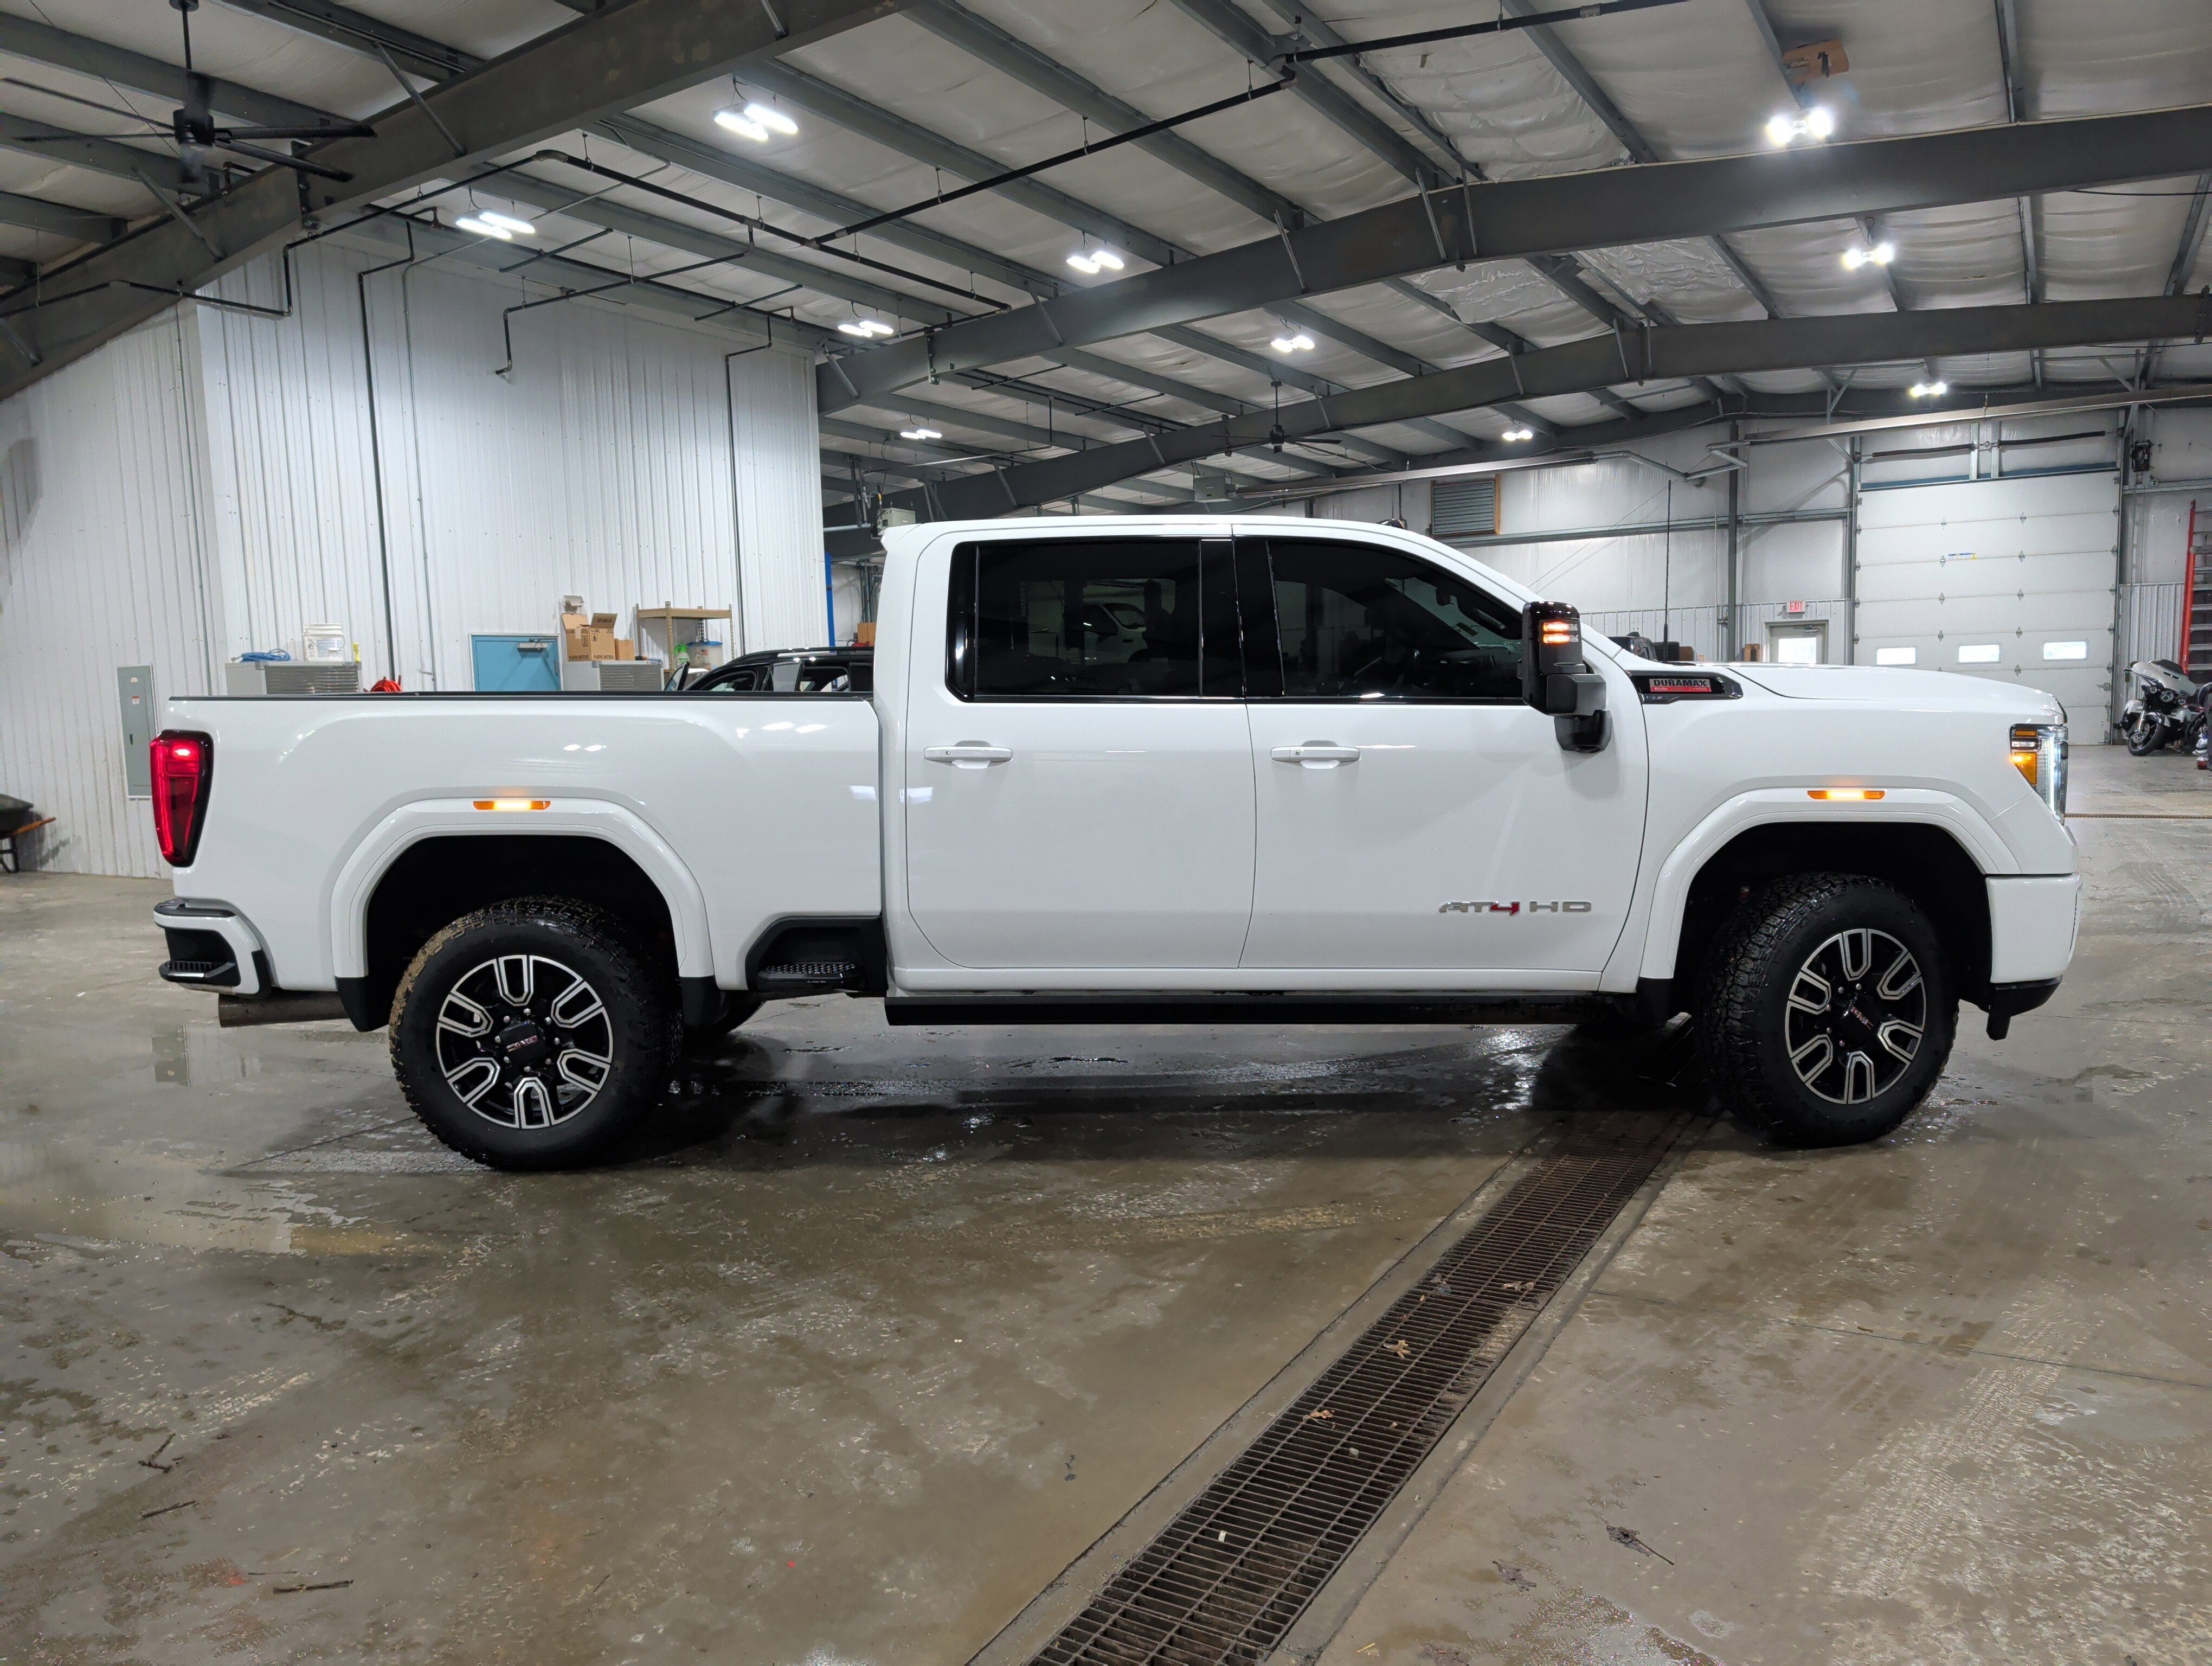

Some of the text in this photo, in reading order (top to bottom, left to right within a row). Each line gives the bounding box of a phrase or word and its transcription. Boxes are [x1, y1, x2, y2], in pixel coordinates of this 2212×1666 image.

[1790, 601, 1803, 611] EXIT
[1438, 901, 1592, 917] AT4 HD
[1850, 1007, 1873, 1030] GMC
